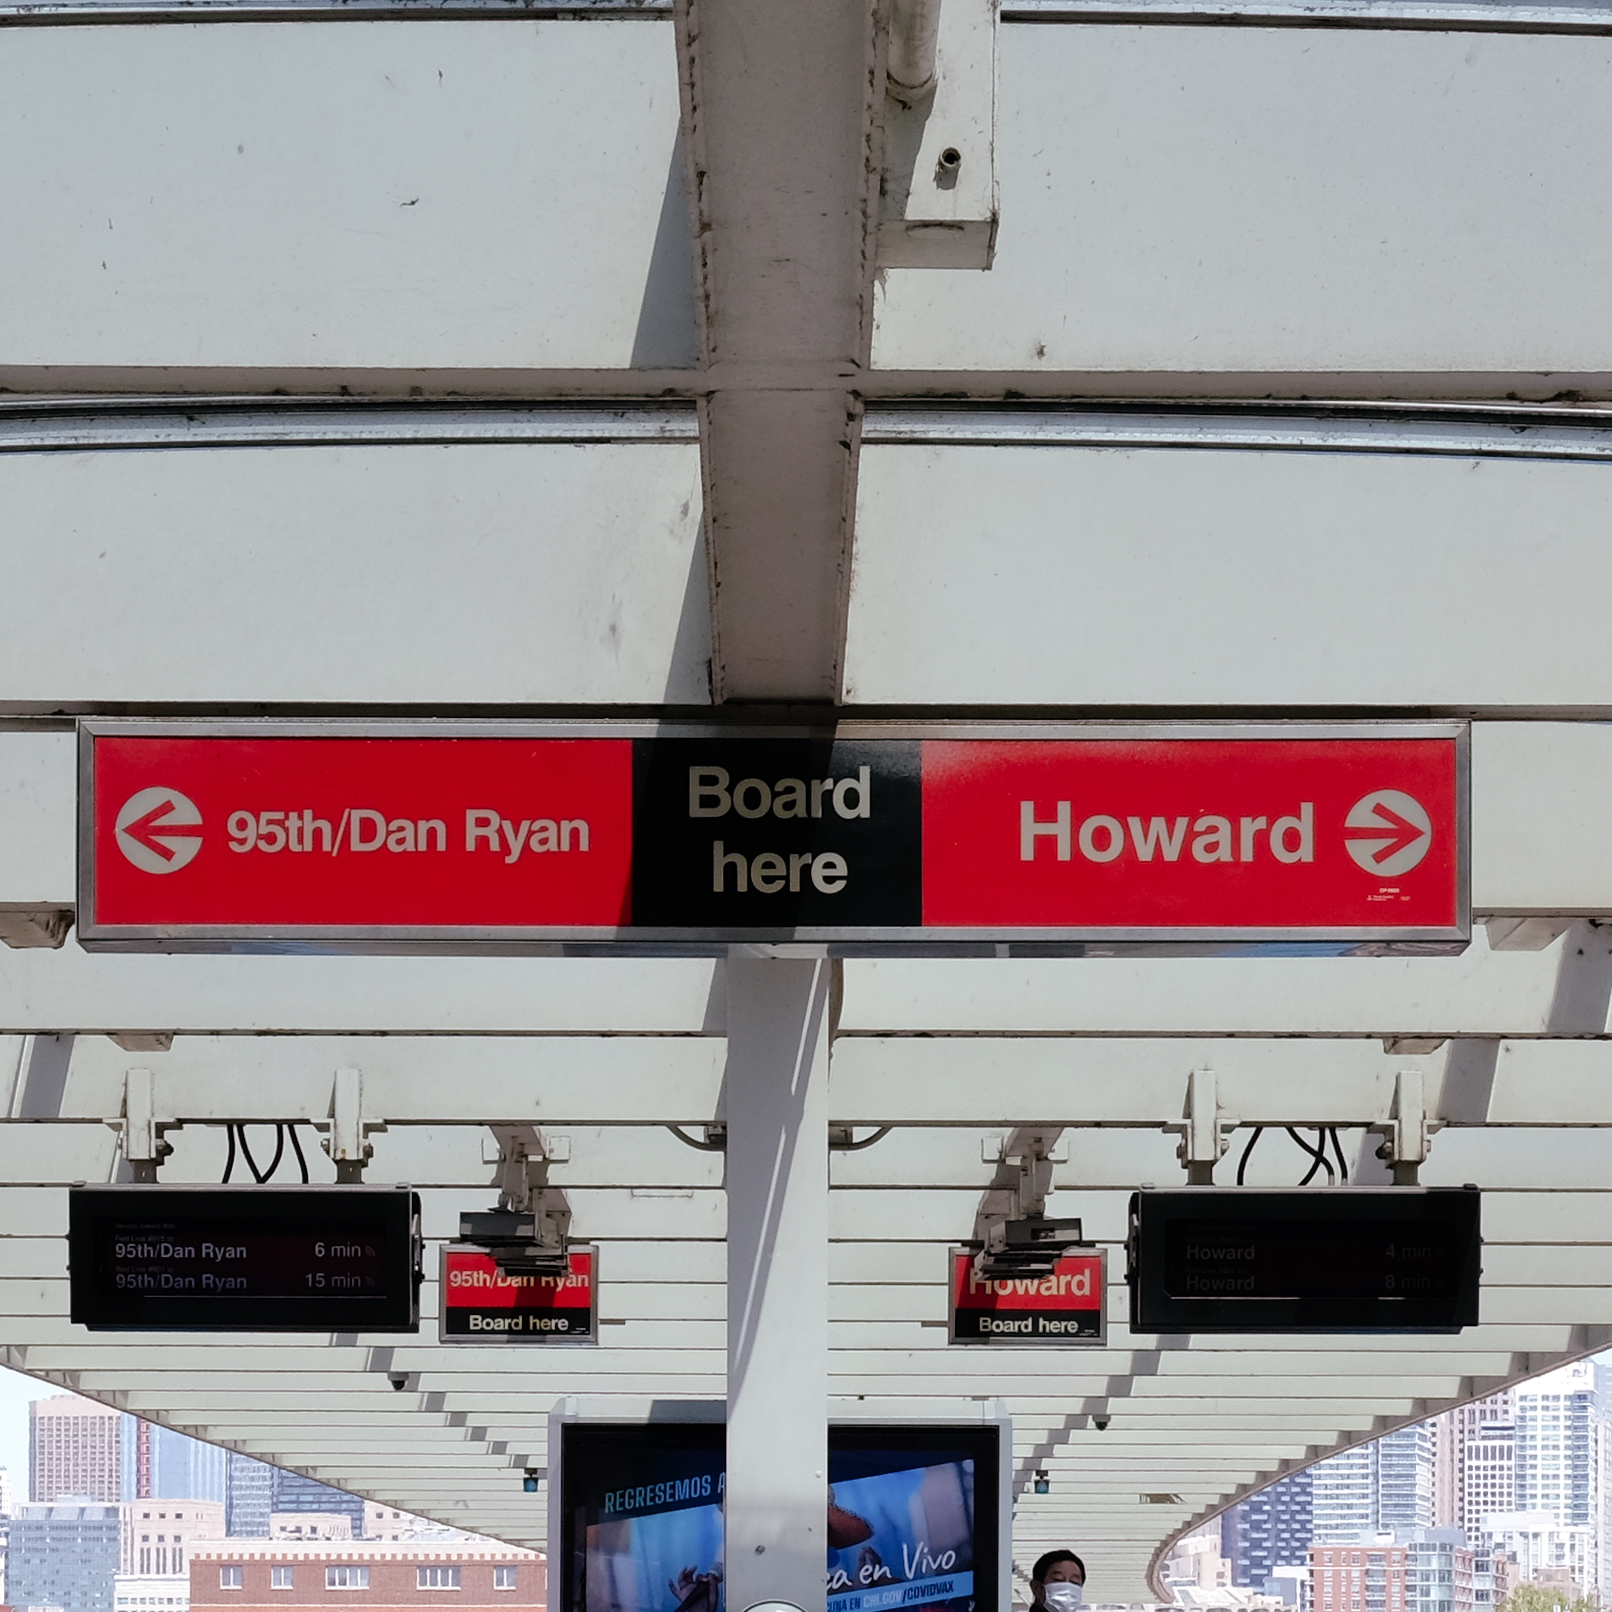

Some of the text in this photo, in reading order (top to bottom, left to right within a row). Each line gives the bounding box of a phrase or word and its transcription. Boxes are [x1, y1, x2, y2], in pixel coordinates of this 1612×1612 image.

[688, 765, 871, 819] Board
[226, 808, 590, 864] 95th/Dan Ryan
[1020, 800, 1314, 864] Howard
[712, 840, 848, 894] here
[115, 1243, 247, 1263] 95th/Dan Ryan
[314, 1242, 361, 1258] 6 min
[1186, 1244, 1256, 1260] Howard
[1385, 1243, 1431, 1259] 4 min
[115, 1273, 247, 1292] 95th/Dan Ryan
[305, 1272, 361, 1288] 15 min
[449, 1270, 534, 1288] 95th/Dan
[969, 1268, 1091, 1296] Howard
[1186, 1275, 1256, 1291] Howard
[1385, 1273, 1431, 1289] 8 min
[469, 1315, 523, 1331] Board
[529, 1315, 569, 1331] here
[980, 1317, 1032, 1333] Board
[1038, 1317, 1079, 1333] here
[604, 1475, 711, 1513] REGRESEMOS
[859, 1563, 892, 1584] en
[902, 1541, 956, 1580] Vivo
